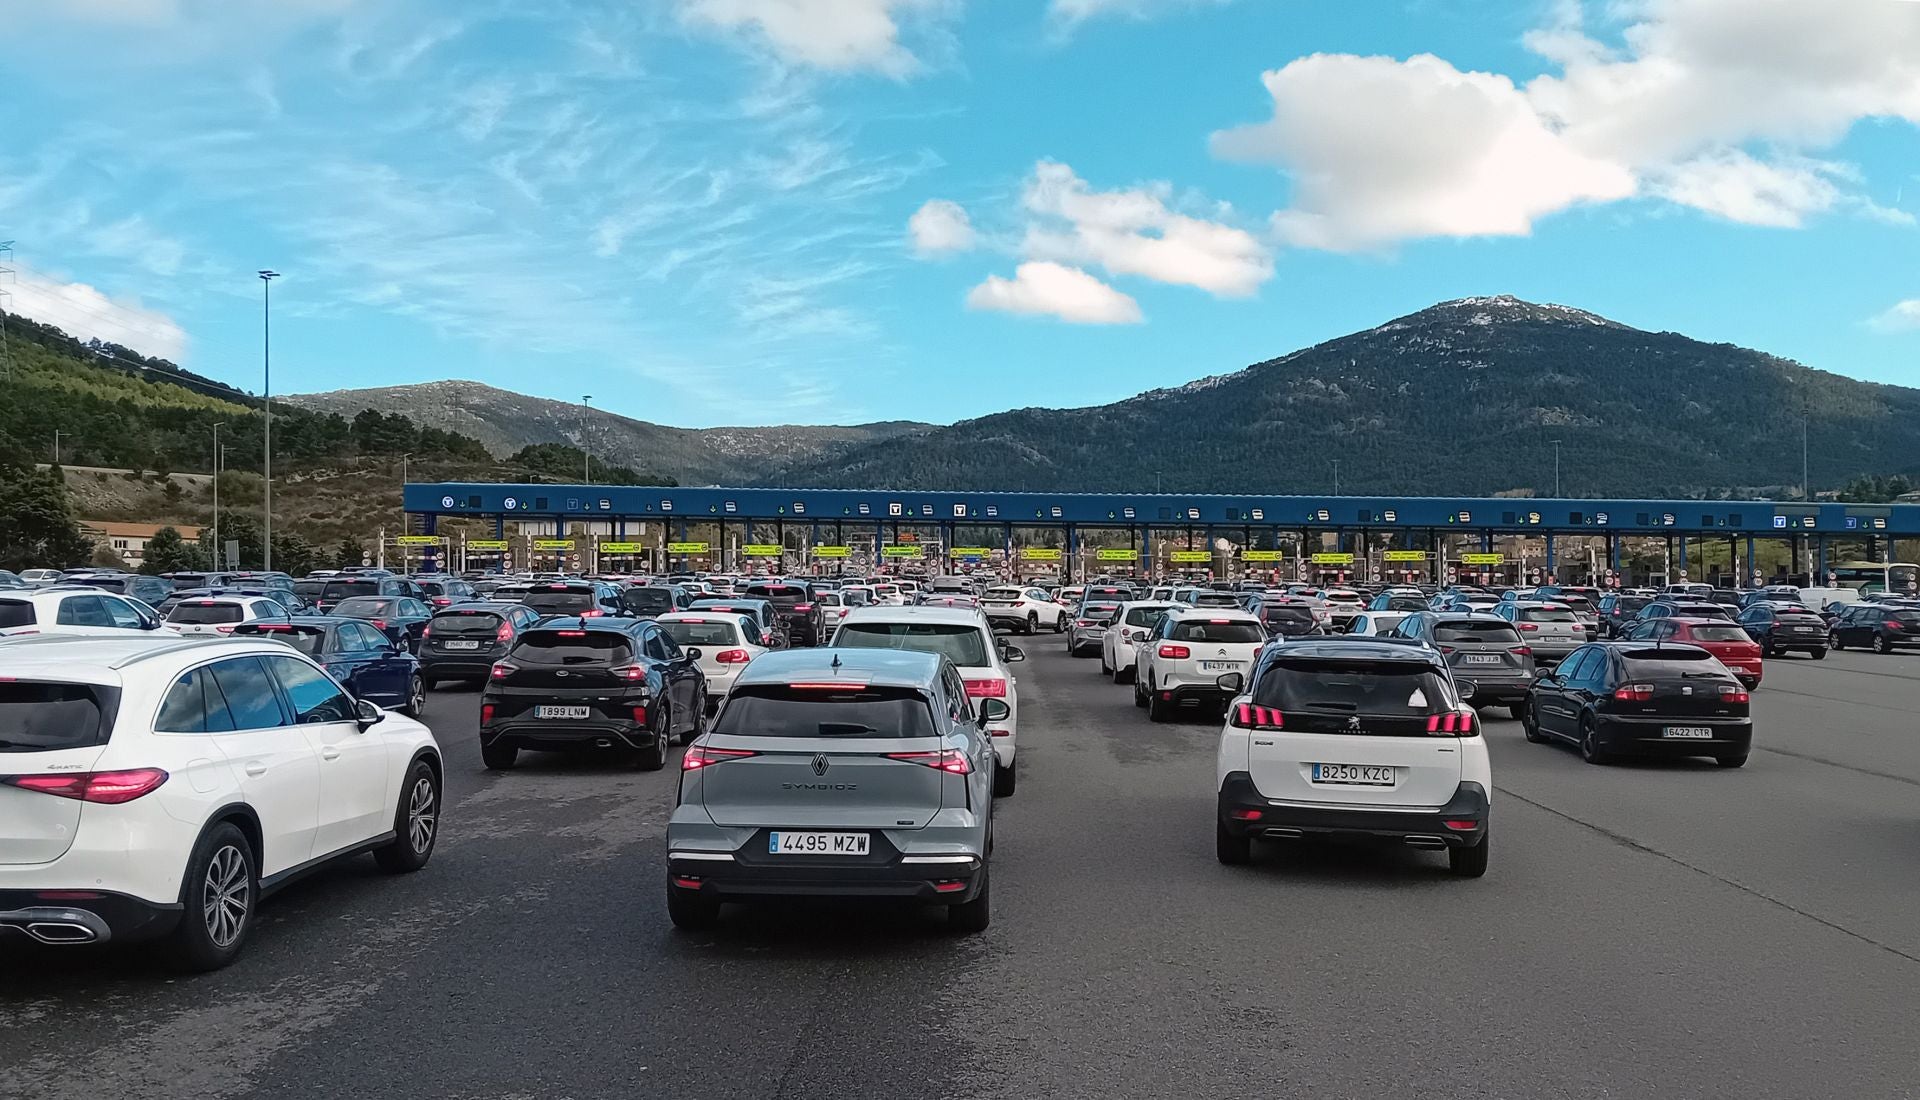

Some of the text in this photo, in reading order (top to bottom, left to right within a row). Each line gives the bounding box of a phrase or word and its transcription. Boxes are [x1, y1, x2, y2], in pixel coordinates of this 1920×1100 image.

[1207, 662, 1225, 670] 6437
[543, 707, 587, 716] 1899 LNM
[1669, 728, 1690, 736] 6422
[1322, 766, 1390, 781] 8250 KZC
[781, 783, 858, 791] SYMBIOZ
[783, 835, 867, 852] 4495 MZW
